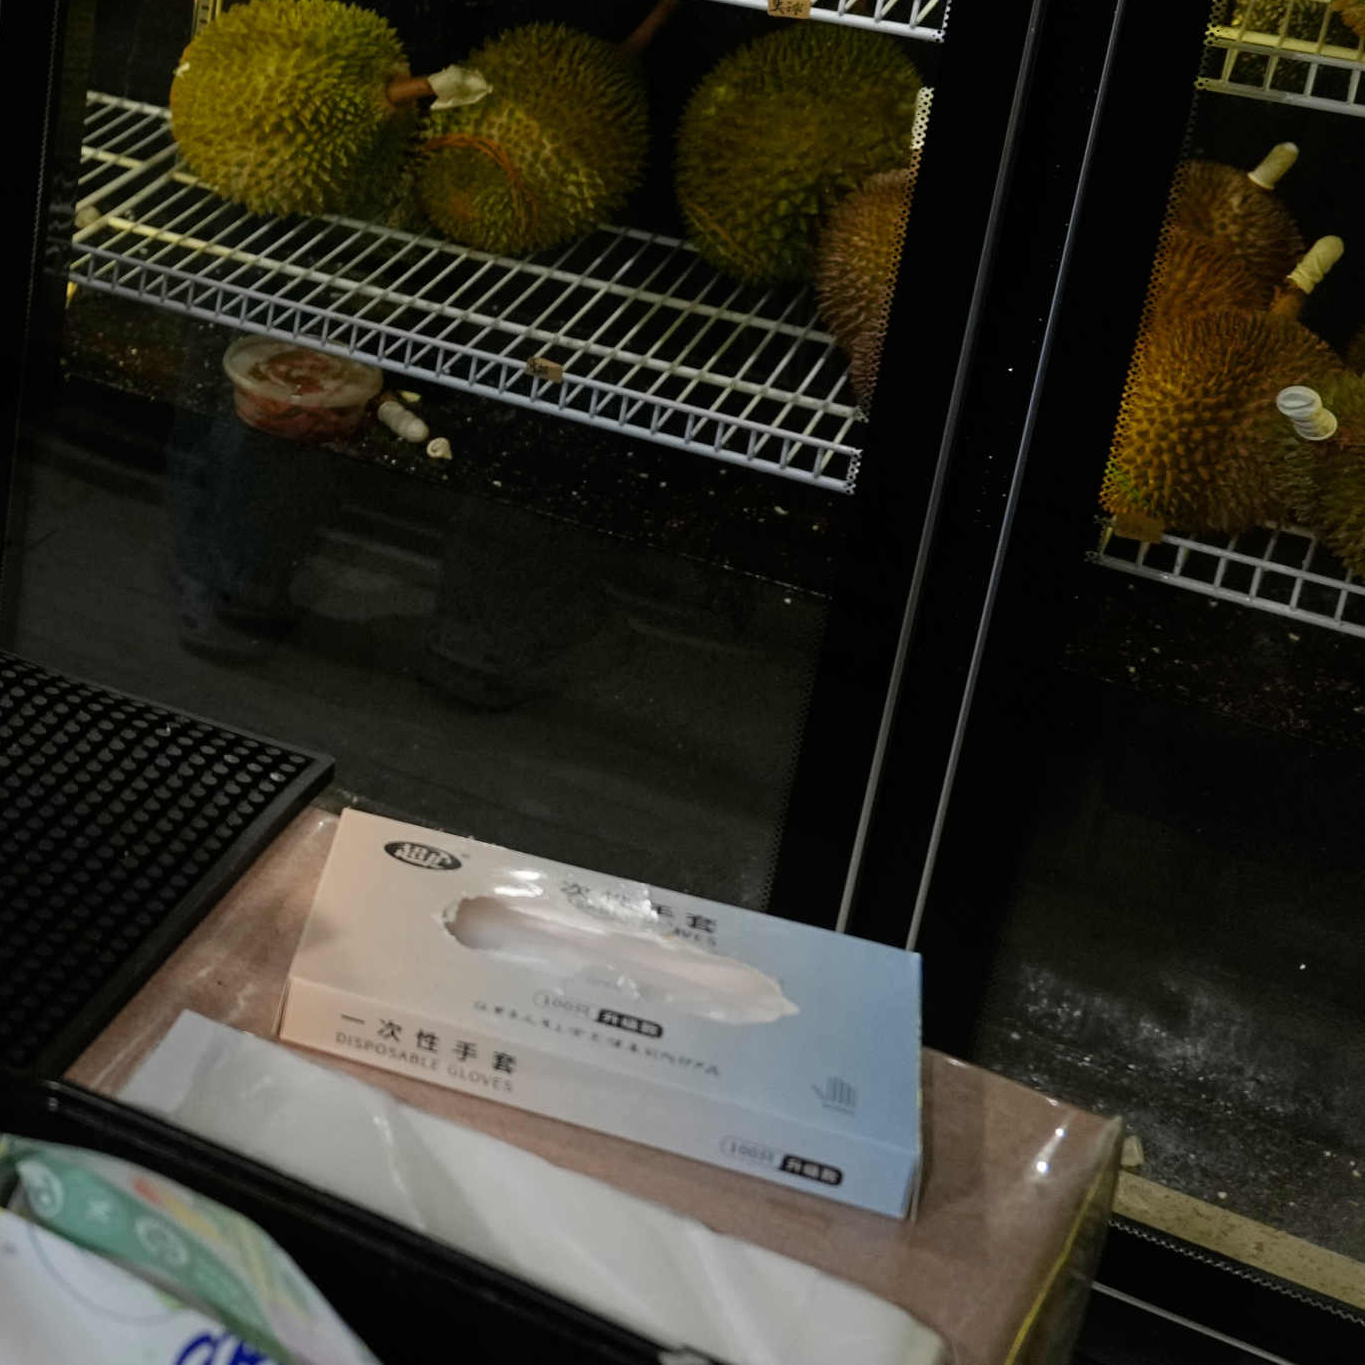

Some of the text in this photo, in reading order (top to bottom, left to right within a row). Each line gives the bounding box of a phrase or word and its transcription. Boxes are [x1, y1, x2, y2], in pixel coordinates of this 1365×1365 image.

[335, 1031, 440, 1073] DISPOSABLE
[446, 1063, 514, 1094] GLOVES
[340, 1012, 518, 1076] 一次性手套
